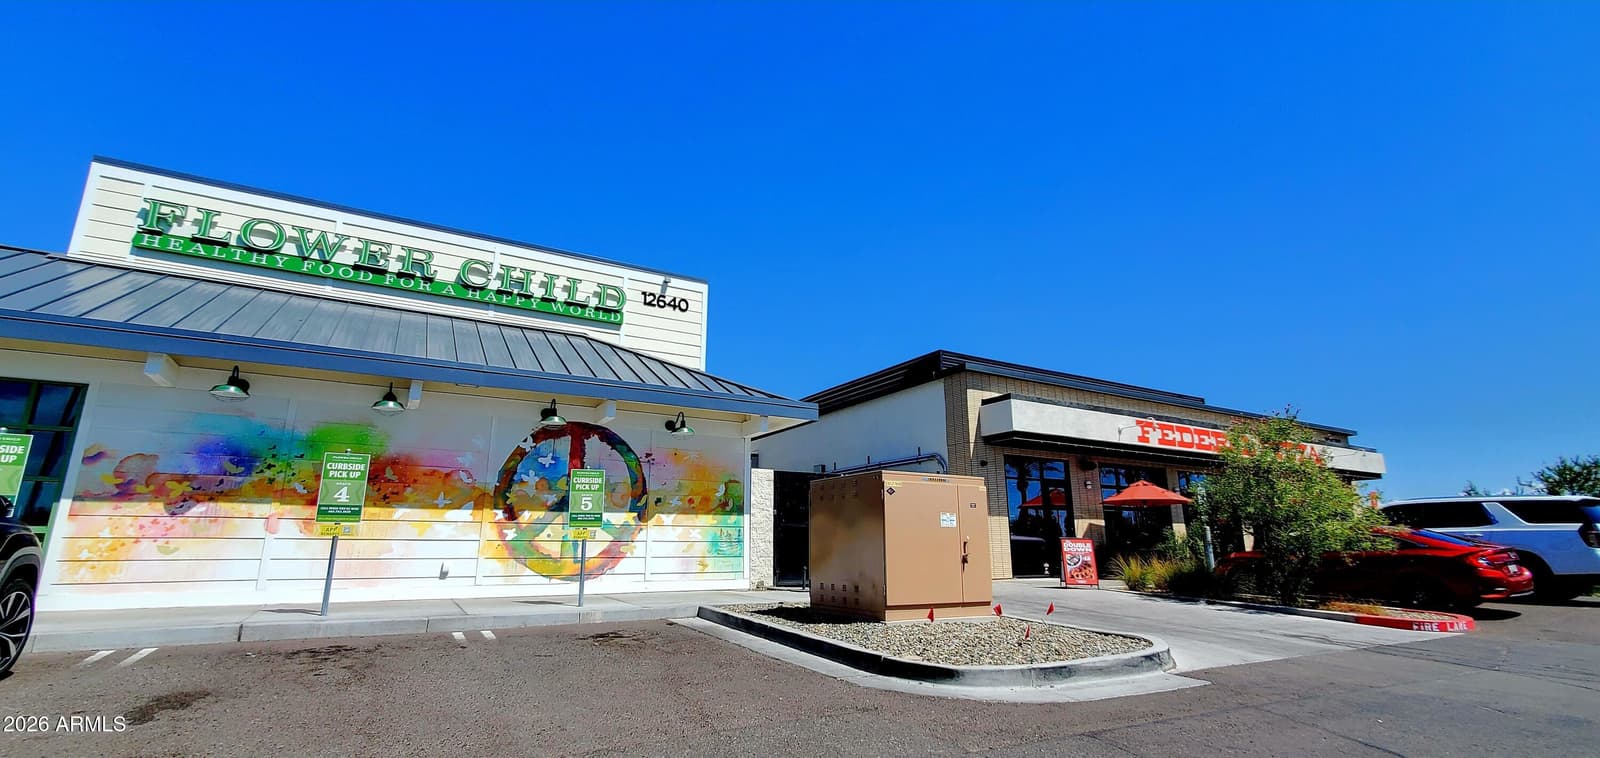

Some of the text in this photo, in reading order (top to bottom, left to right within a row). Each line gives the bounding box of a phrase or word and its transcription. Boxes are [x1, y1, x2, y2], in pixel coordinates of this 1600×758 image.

[137, 197, 627, 313] FLOWER CHILD
[140, 233, 622, 321] HEALTHY FOOD FOR A HAPPY WORLD
[641, 291, 690, 313] 12640
[0, 445, 24, 454] SIDE
[1, 455, 17, 463] UP
[326, 462, 366, 471] CURBSIDE
[333, 486, 349, 502] 4
[581, 496, 593, 511] 5
[1412, 622, 1467, 632] FIRE LANE
